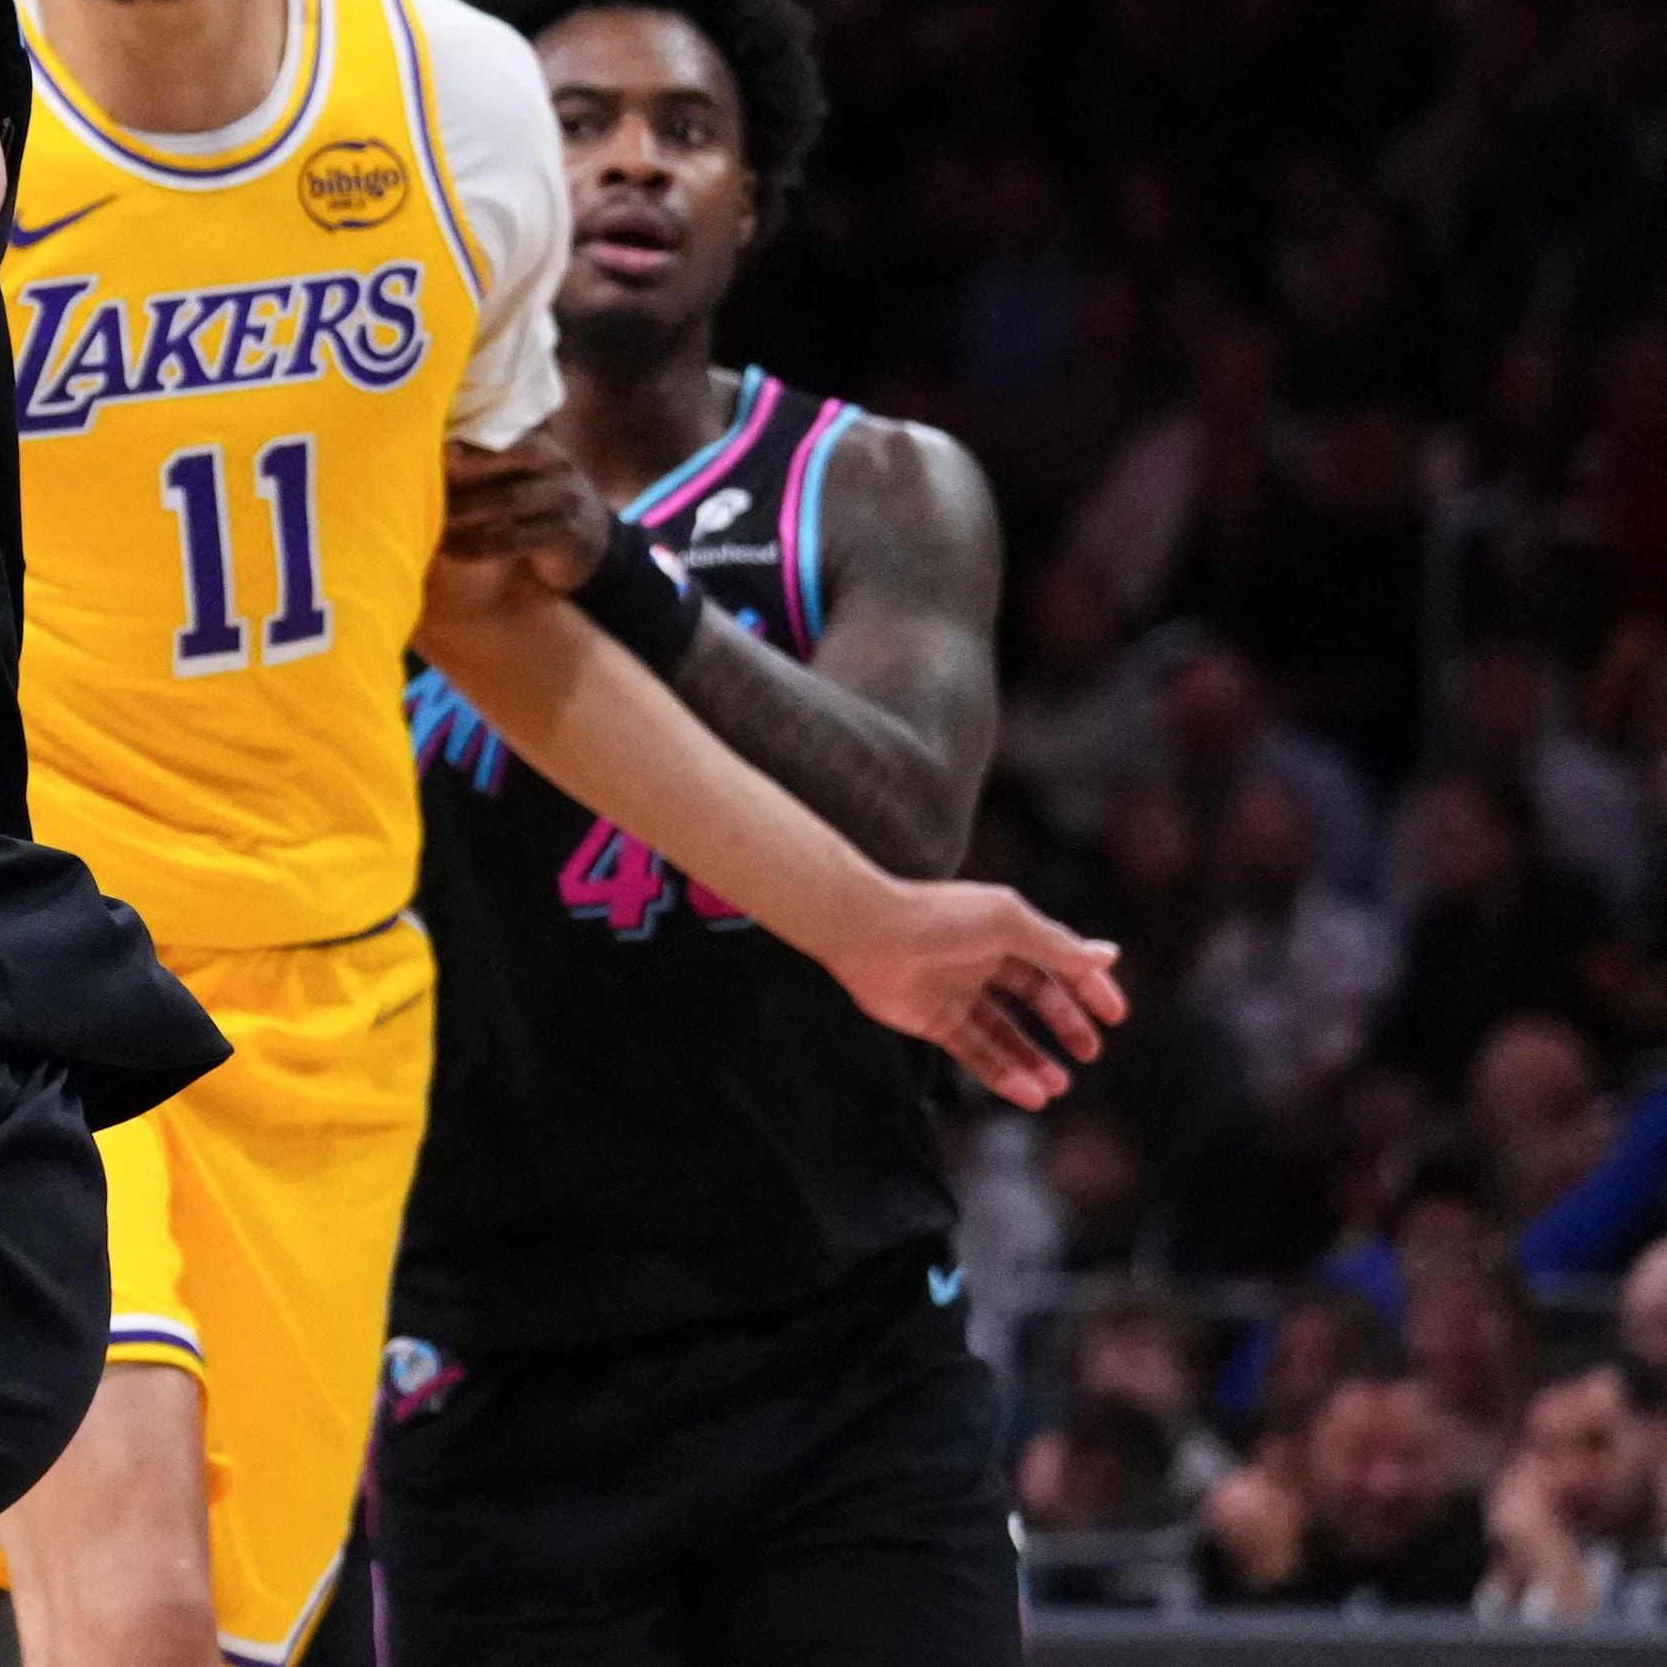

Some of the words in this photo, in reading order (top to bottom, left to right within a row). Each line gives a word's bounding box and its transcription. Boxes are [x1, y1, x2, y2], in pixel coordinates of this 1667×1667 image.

[15, 260, 430, 441] LAKERS
[161, 433, 333, 680] 11
[557, 816, 757, 941] 4
